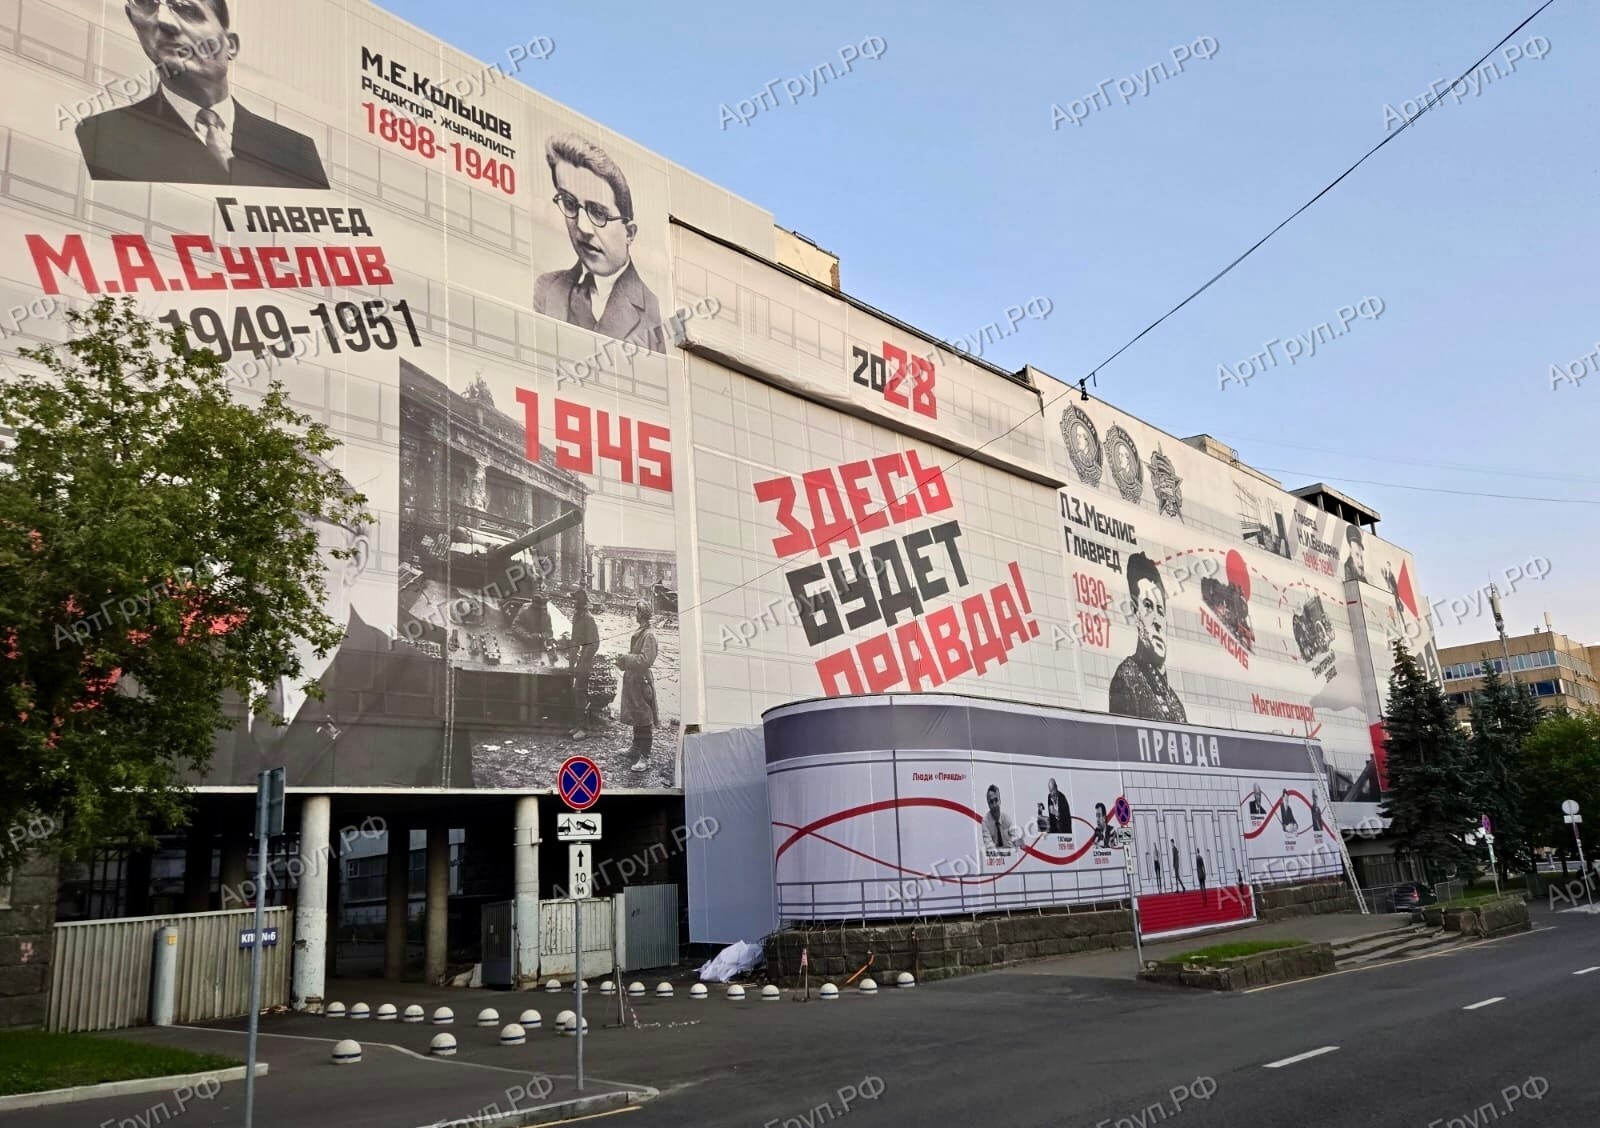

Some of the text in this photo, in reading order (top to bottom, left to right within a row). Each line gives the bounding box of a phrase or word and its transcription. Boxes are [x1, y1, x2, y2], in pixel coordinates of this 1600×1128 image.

[361, 46, 512, 140] М.Е.Кольцов
[361, 102, 515, 194] 1898-1940
[216, 197, 372, 236] Главред
[25, 234, 393, 295] М.А.Суслов
[158, 298, 421, 364] 1949-1951
[853, 341, 937, 420] 2028
[515, 387, 672, 492] 1945
[754, 450, 953, 558] ЗДЕСЬ
[1064, 526, 1122, 574] Главред
[785, 520, 969, 647] БУДЕТ
[815, 561, 1040, 697] ПРАВДА!
[1077, 611, 1110, 648] 1937
[1200, 606, 1248, 670] ТУРКСИБ
[1137, 728, 1221, 767] ПРАВДА
[575, 872, 587, 883] 10
